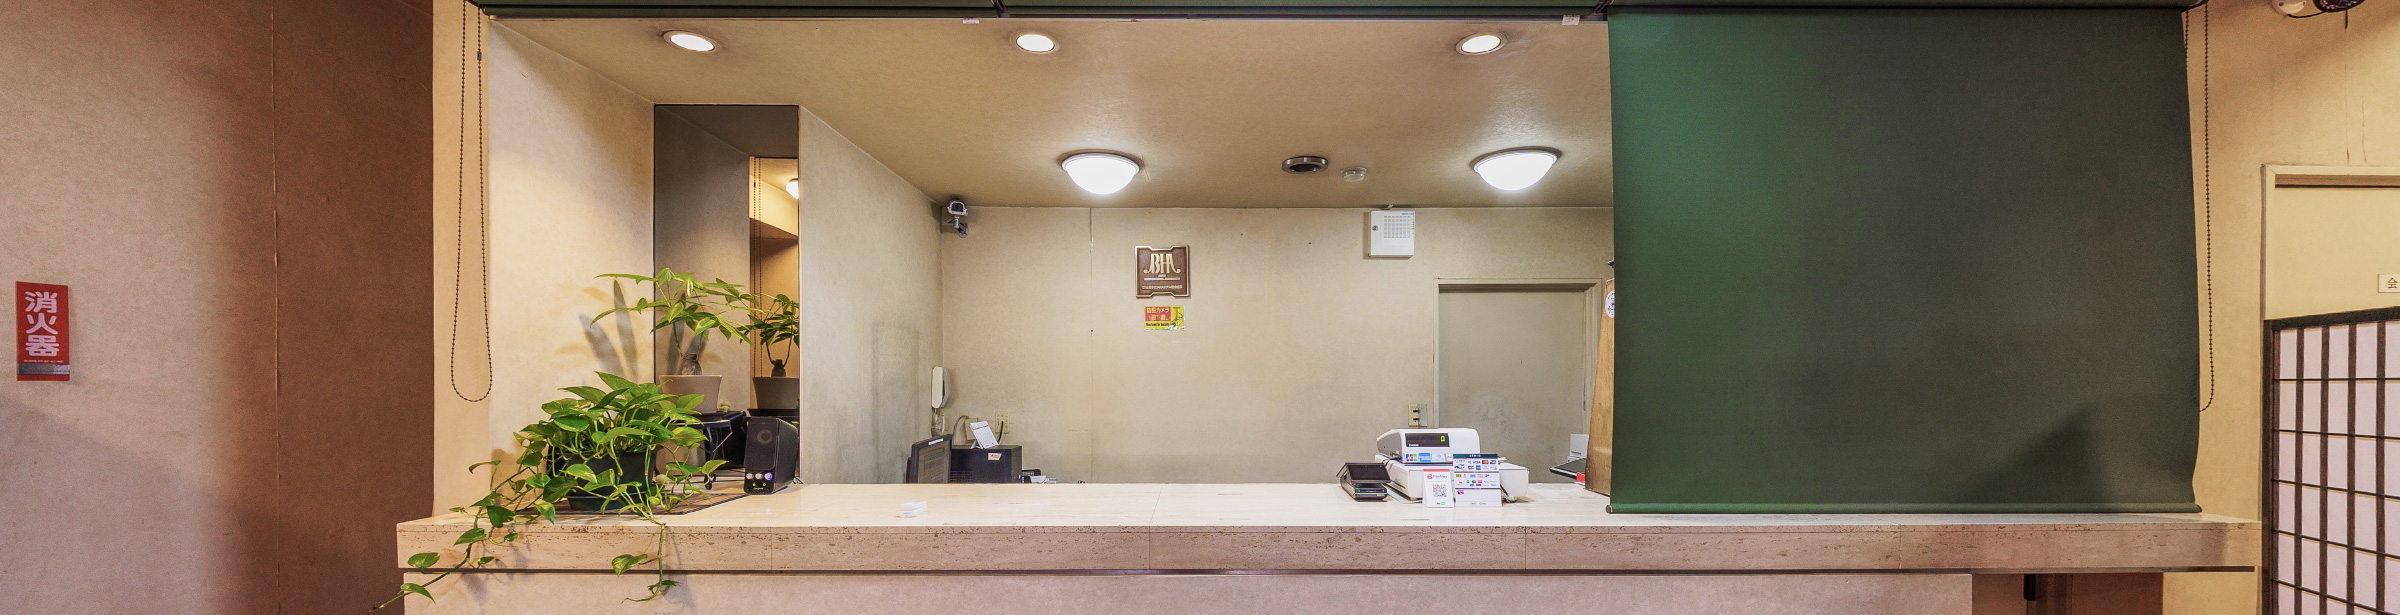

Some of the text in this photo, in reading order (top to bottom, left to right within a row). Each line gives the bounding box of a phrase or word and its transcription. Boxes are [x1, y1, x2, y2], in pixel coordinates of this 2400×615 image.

[2386, 277, 2399, 289] 会
[25, 291, 60, 357] 消火器
